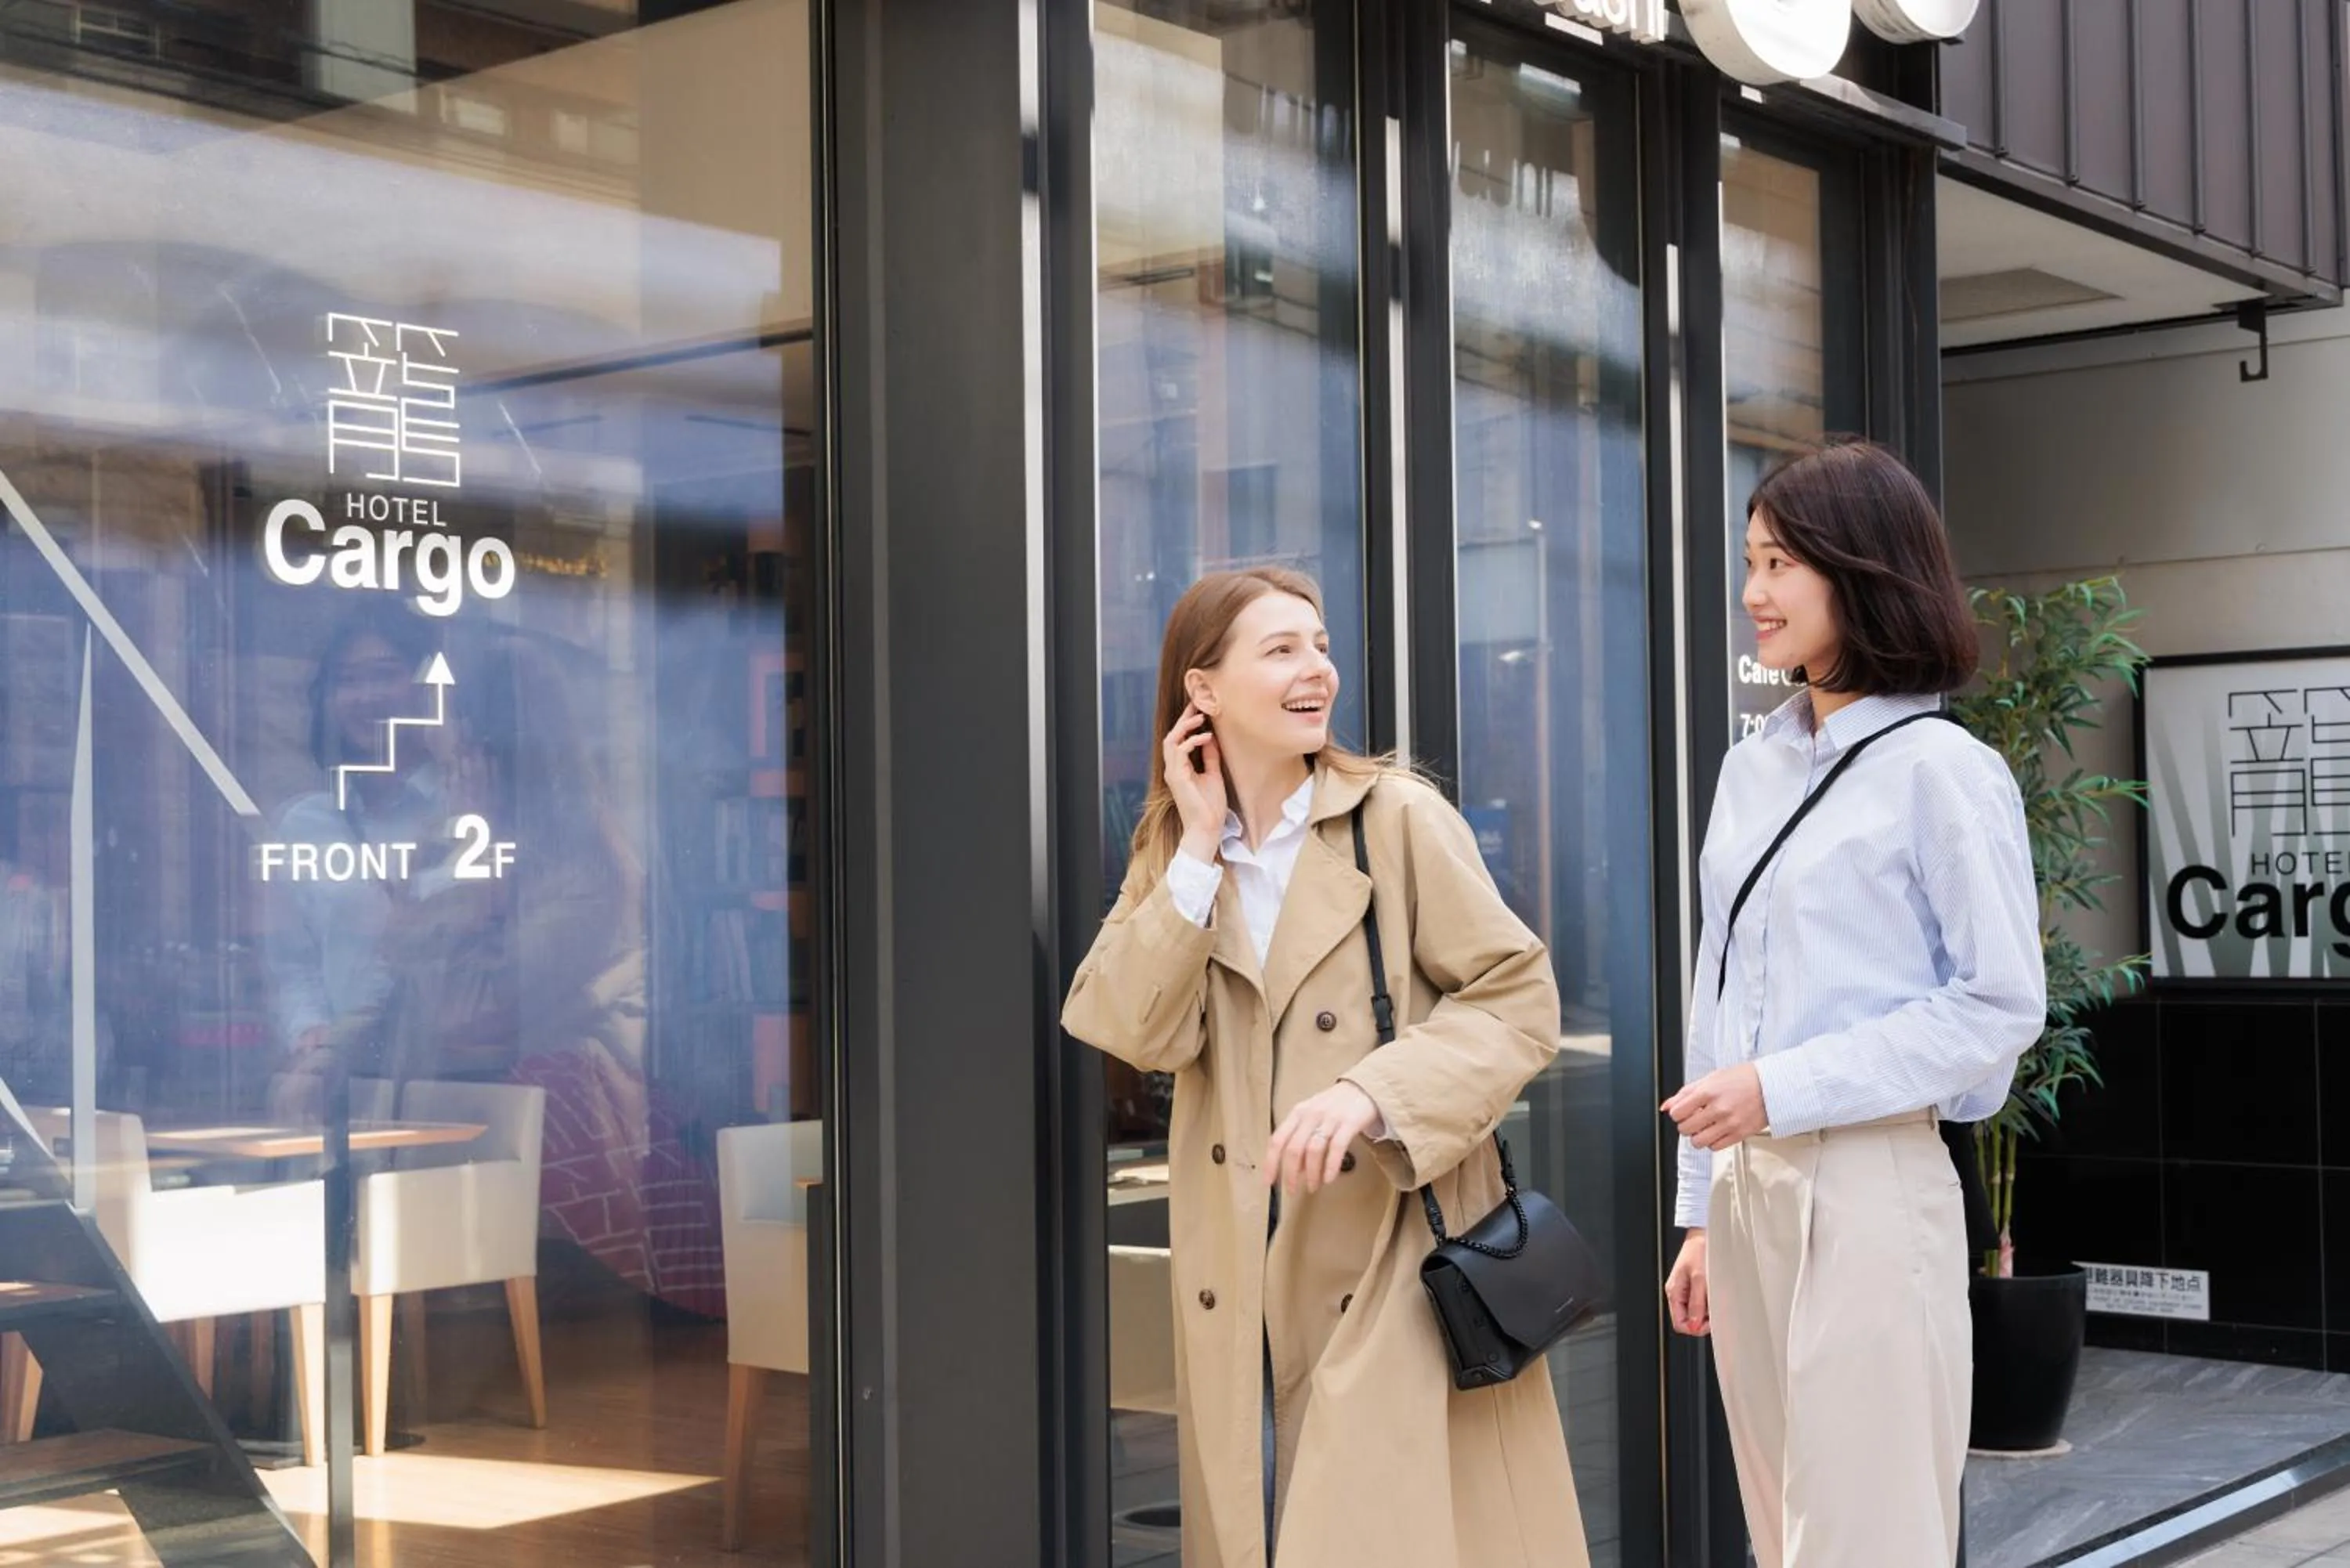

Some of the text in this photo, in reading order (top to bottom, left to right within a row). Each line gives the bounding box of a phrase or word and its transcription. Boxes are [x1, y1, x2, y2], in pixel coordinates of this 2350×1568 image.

[346, 493, 447, 527] HOTEL
[265, 499, 516, 617] Cargo
[1740, 714, 1768, 738] 7:0
[262, 814, 516, 881] FRONT 2F
[2251, 851, 2350, 876] HOTE
